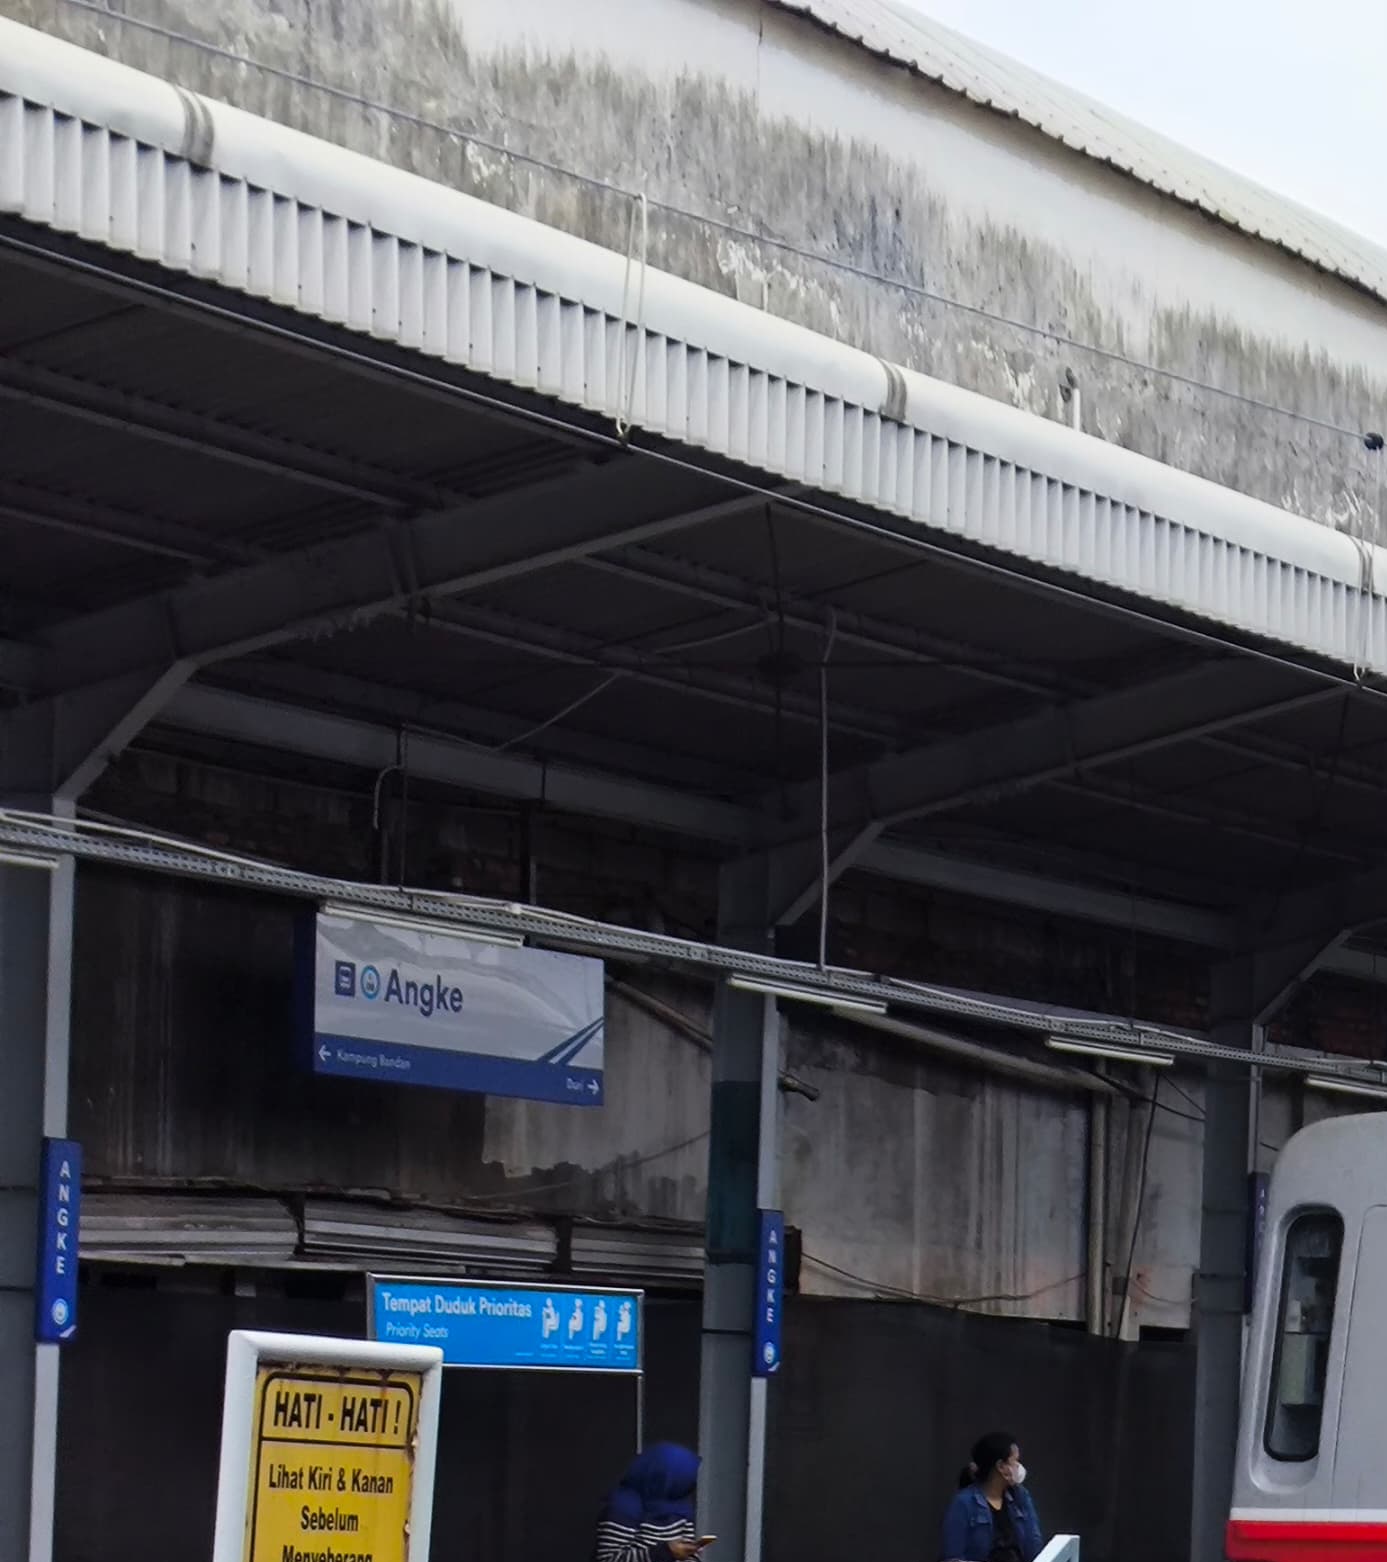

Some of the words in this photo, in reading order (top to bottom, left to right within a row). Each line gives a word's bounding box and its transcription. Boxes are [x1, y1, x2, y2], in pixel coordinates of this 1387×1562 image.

[383, 967, 464, 1018] Angke
[55, 1160, 72, 1275] ANGKE
[766, 1229, 779, 1323] ANGKE
[382, 1291, 432, 1316] Tempat
[435, 1294, 477, 1314] Duduk
[479, 1295, 533, 1318] Prioritas
[386, 1321, 420, 1340] Priority
[423, 1322, 450, 1339] Seats
[273, 1390, 323, 1430] HATI
[340, 1395, 389, 1435] HATI
[268, 1463, 304, 1490] Lihat
[307, 1466, 332, 1491] Kiri
[336, 1470, 347, 1492] &
[351, 1468, 394, 1494] Kanan
[300, 1505, 359, 1533] Sebelum
